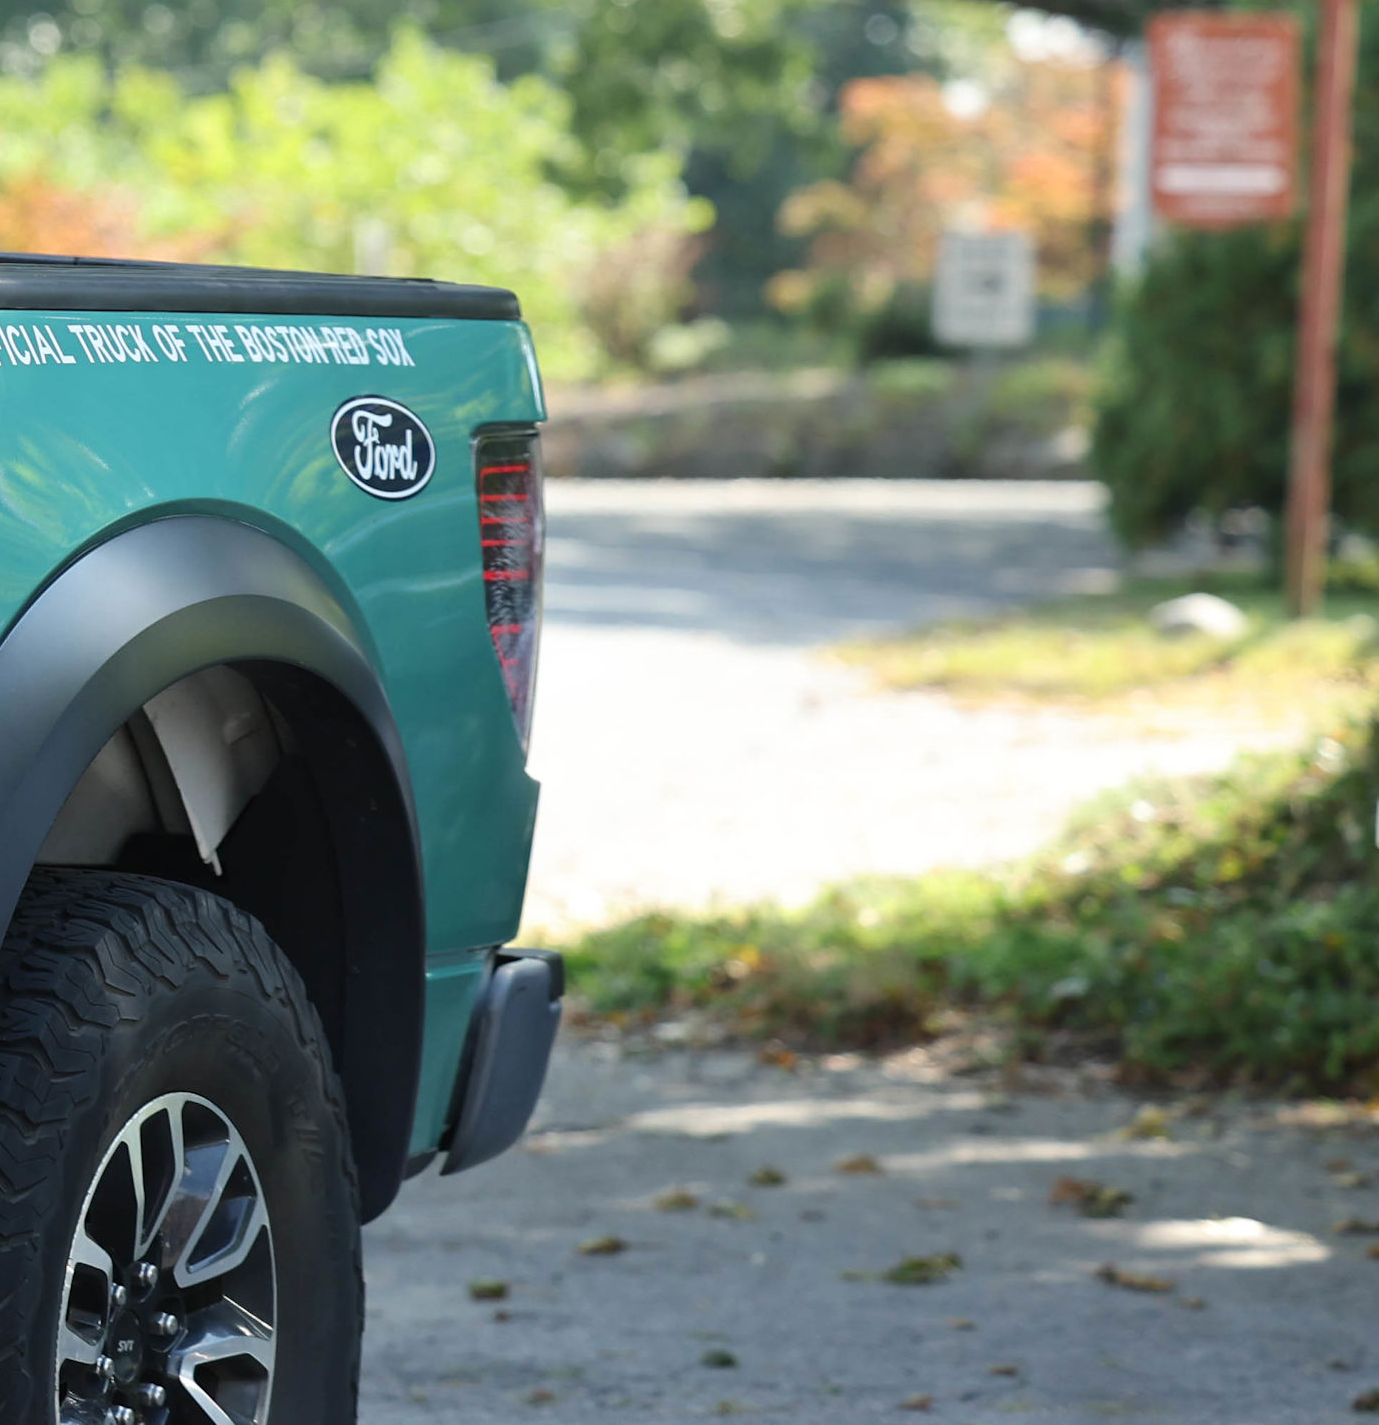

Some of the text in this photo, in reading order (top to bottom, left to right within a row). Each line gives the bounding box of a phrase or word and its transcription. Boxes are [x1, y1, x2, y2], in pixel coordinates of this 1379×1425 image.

[67, 324, 159, 363] TRUCK
[152, 324, 188, 362] OF
[186, 324, 245, 362] THE
[234, 325, 330, 364] BOSTON
[320, 326, 370, 365] RED
[366, 327, 416, 366] SOX
[351, 410, 418, 480] Ford
